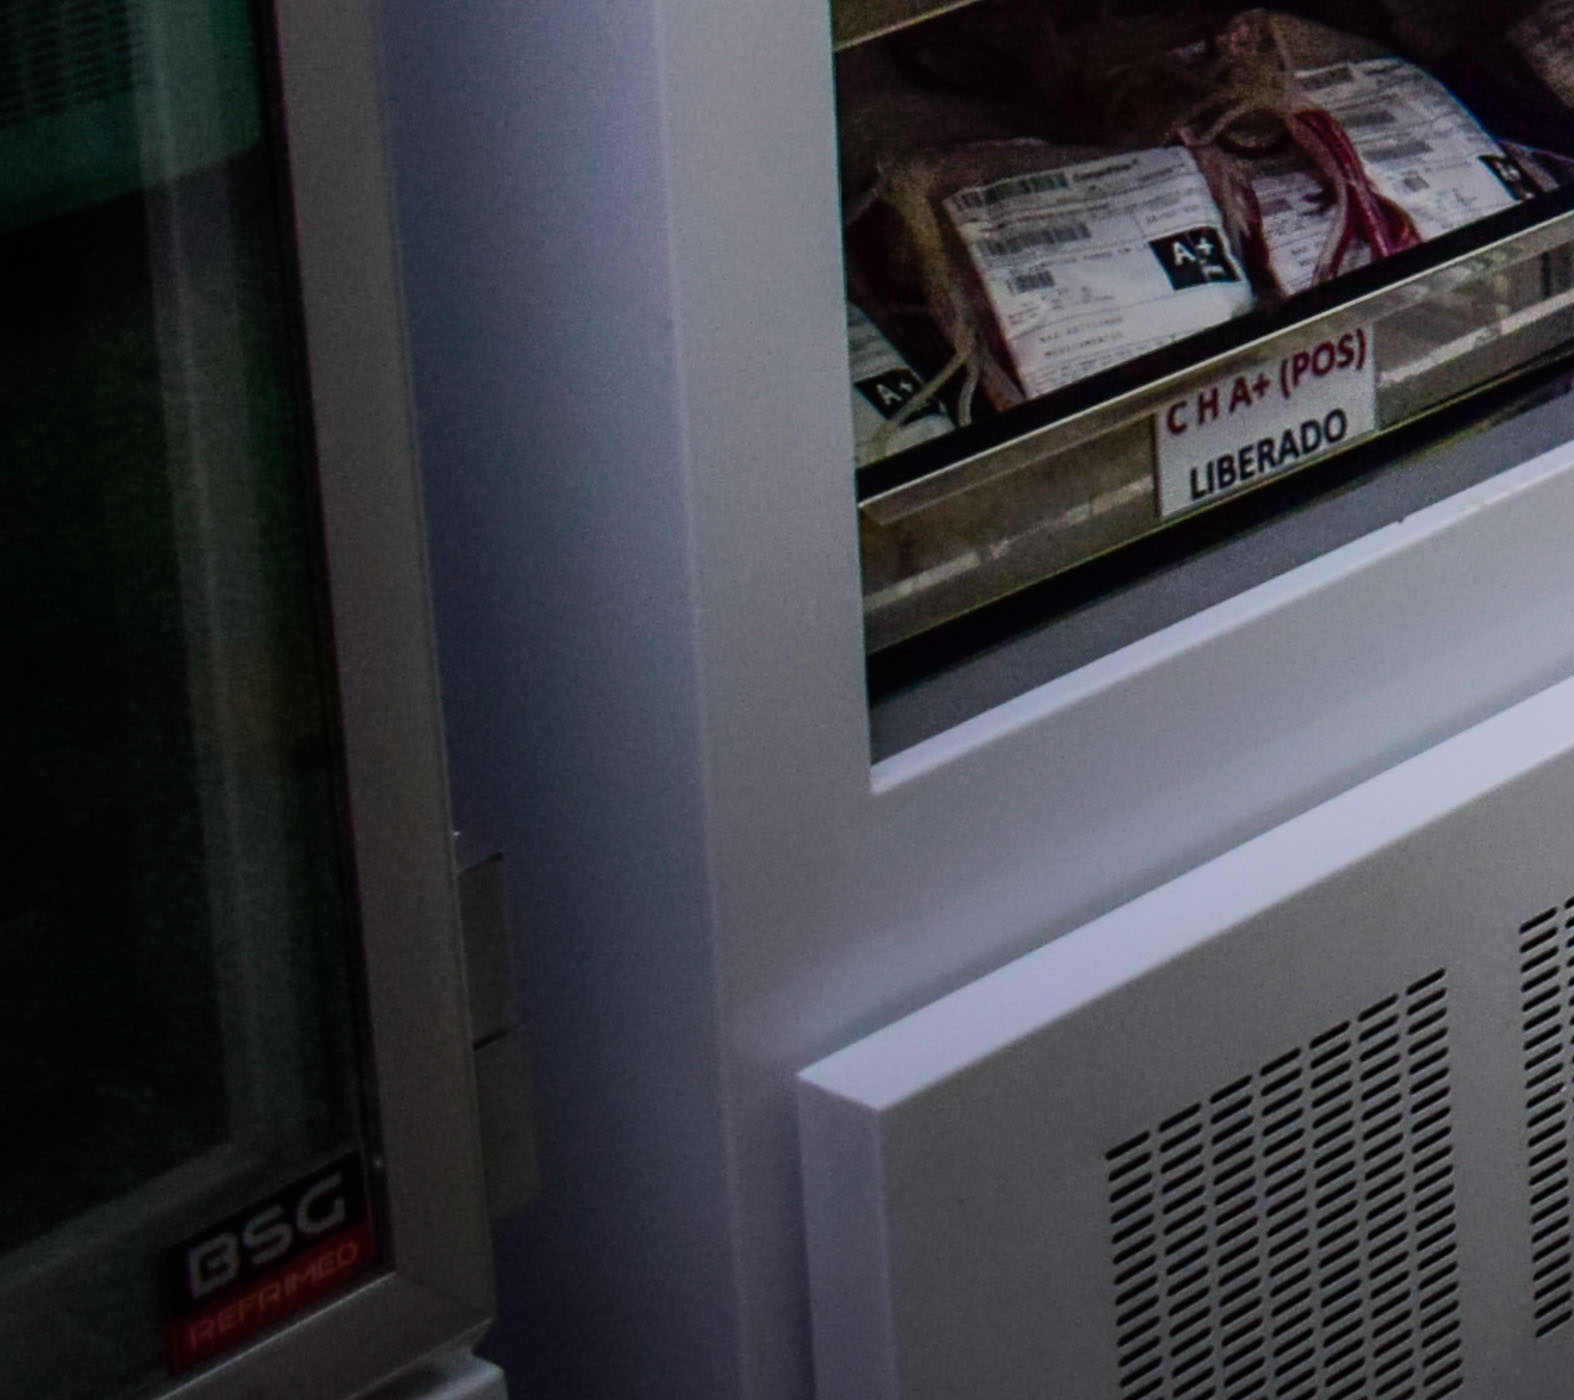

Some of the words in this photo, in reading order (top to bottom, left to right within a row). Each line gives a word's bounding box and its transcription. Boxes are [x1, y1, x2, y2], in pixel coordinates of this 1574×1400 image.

[1170, 236, 1215, 267] A+
[875, 378, 914, 408] A+
[1281, 327, 1367, 398] (POS)
[1189, 407, 1348, 501] LIBERADO
[187, 1173, 347, 1299] BSG
[187, 1240, 359, 1353] REFRIMED
